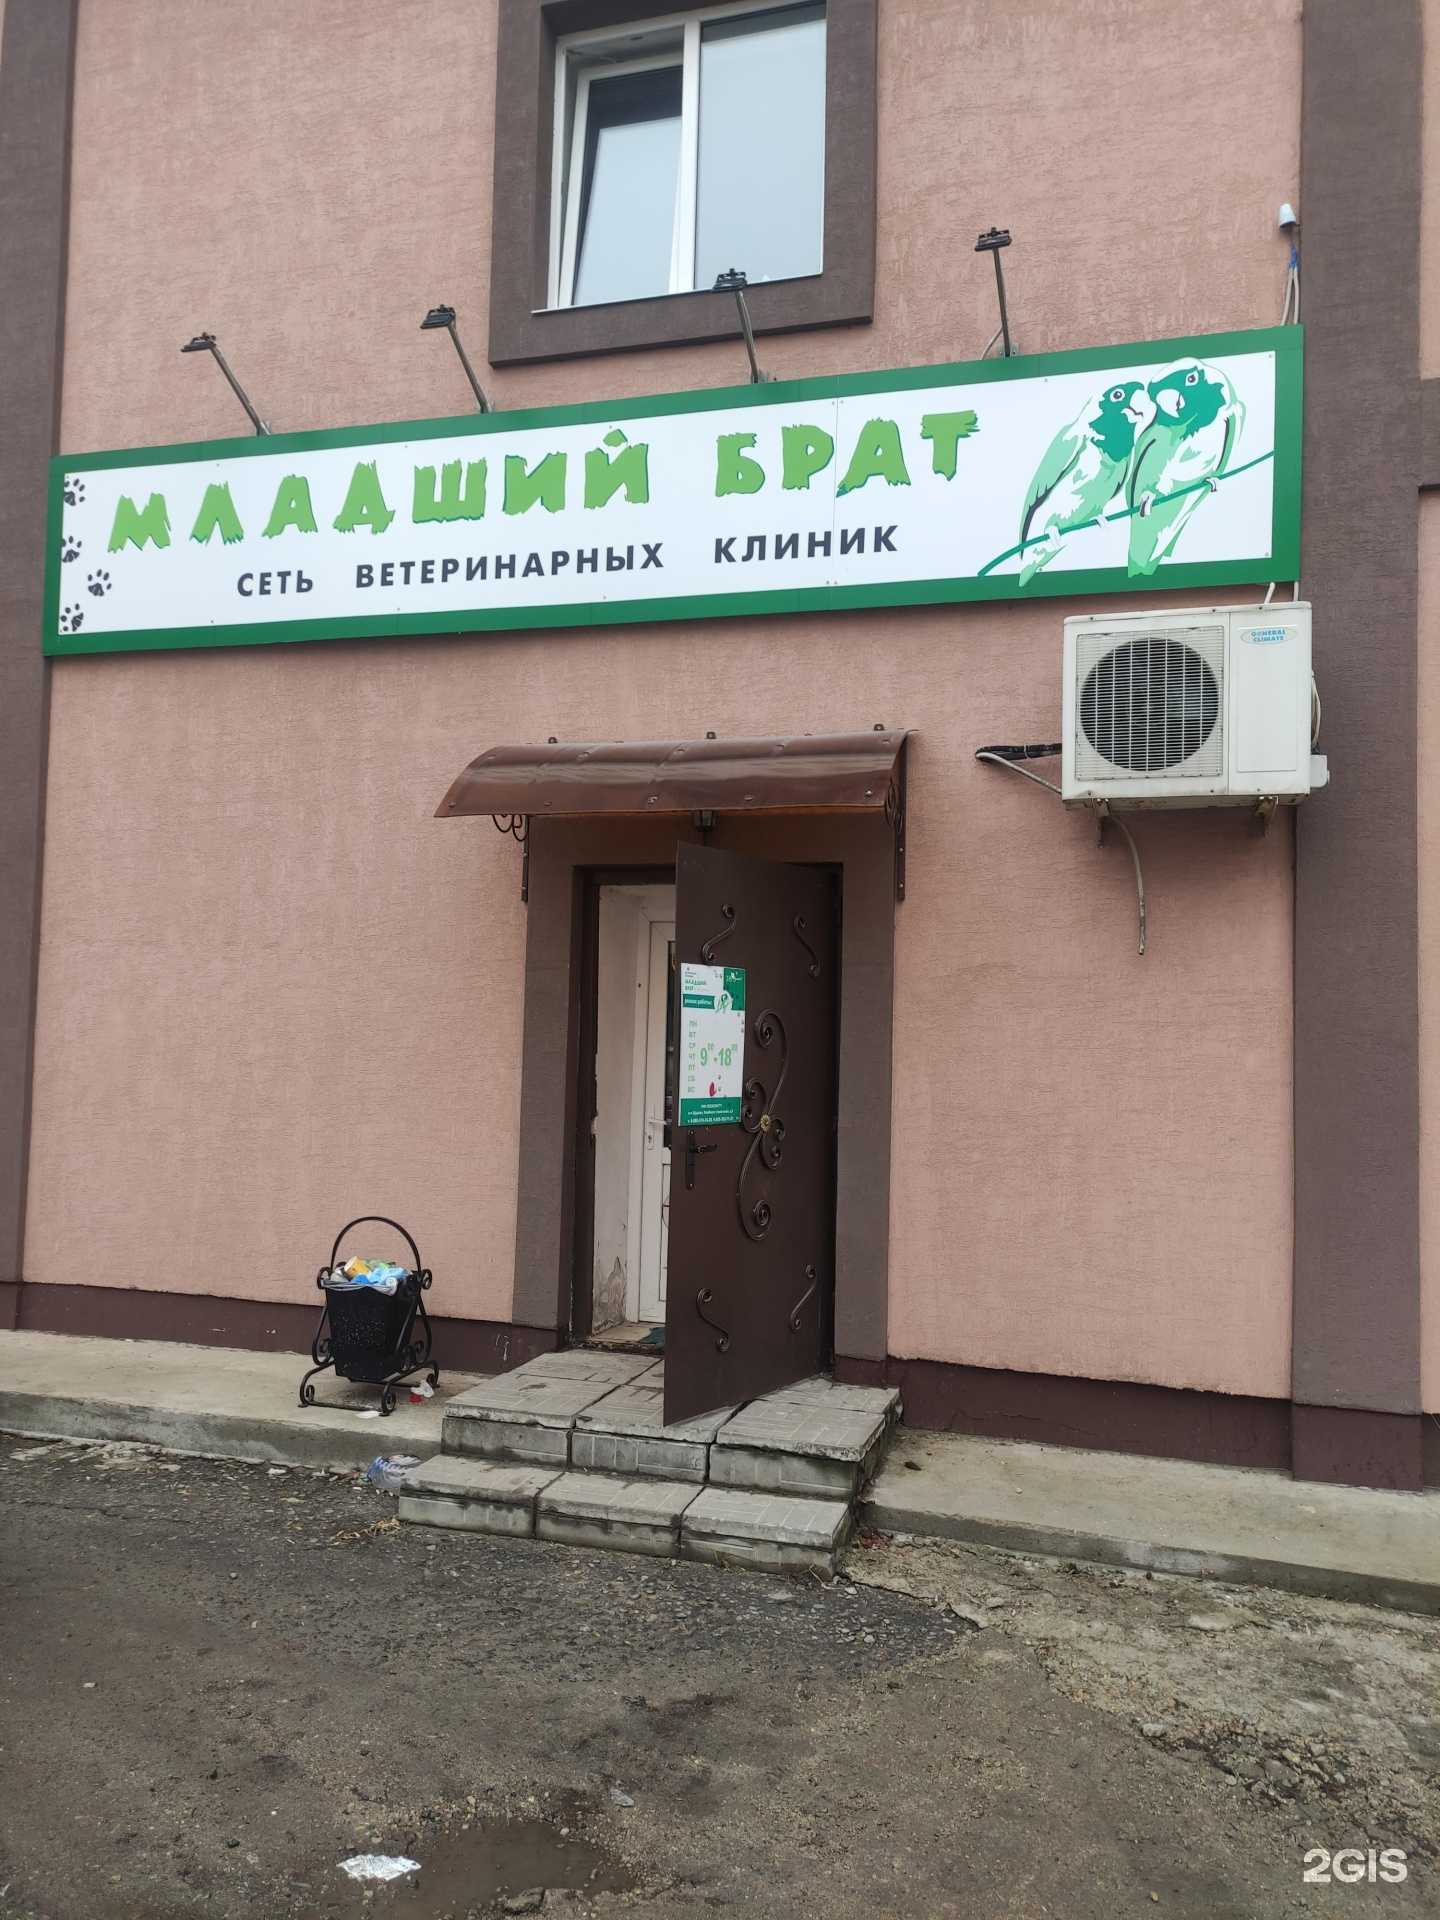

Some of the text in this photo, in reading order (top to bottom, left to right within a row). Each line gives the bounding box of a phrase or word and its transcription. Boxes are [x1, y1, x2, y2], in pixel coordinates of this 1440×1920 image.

[107, 409, 981, 553] МЛАДШИЙ БРАТ
[236, 525, 899, 597] СЕТЬ ВЕТЕРИНАРНЫХ КЛИНИК
